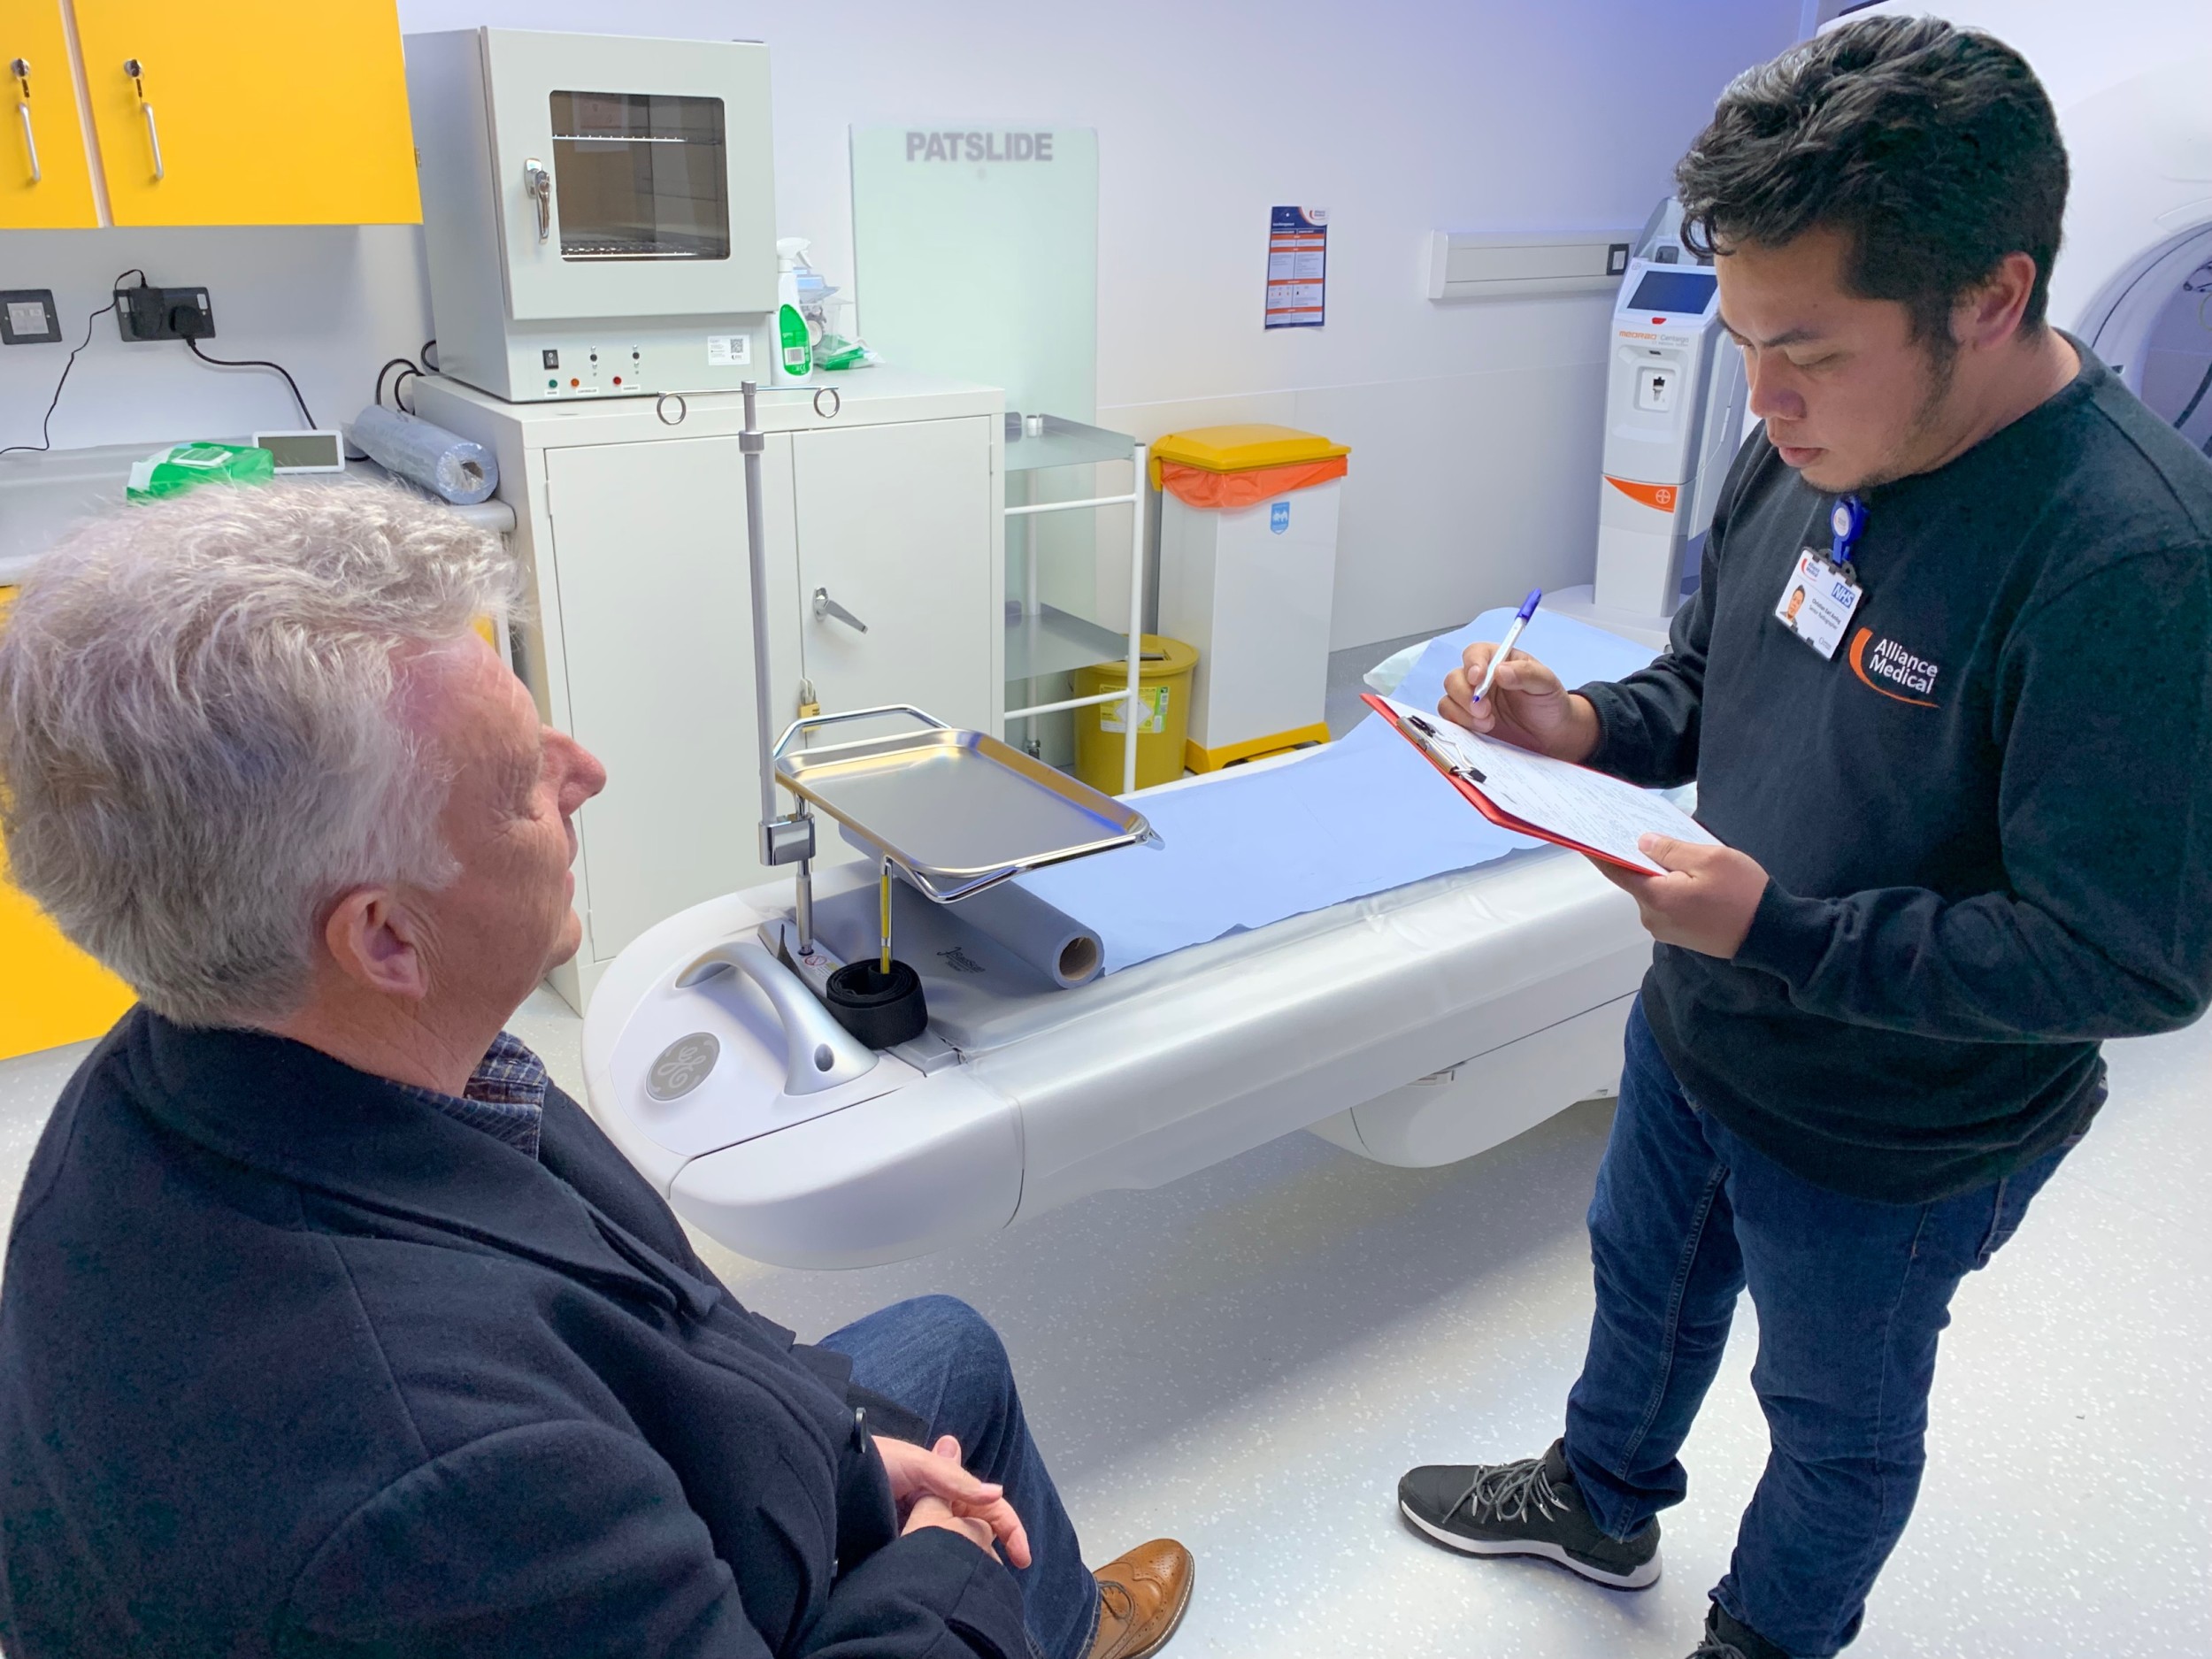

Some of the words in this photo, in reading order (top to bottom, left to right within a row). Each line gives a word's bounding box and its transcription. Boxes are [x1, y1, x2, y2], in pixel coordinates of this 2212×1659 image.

[906, 132, 1053, 162] PATSLIDE
[1832, 585, 1855, 606] NHS
[1869, 655, 1935, 695] Medical
[1874, 638, 1938, 678] Alliance
